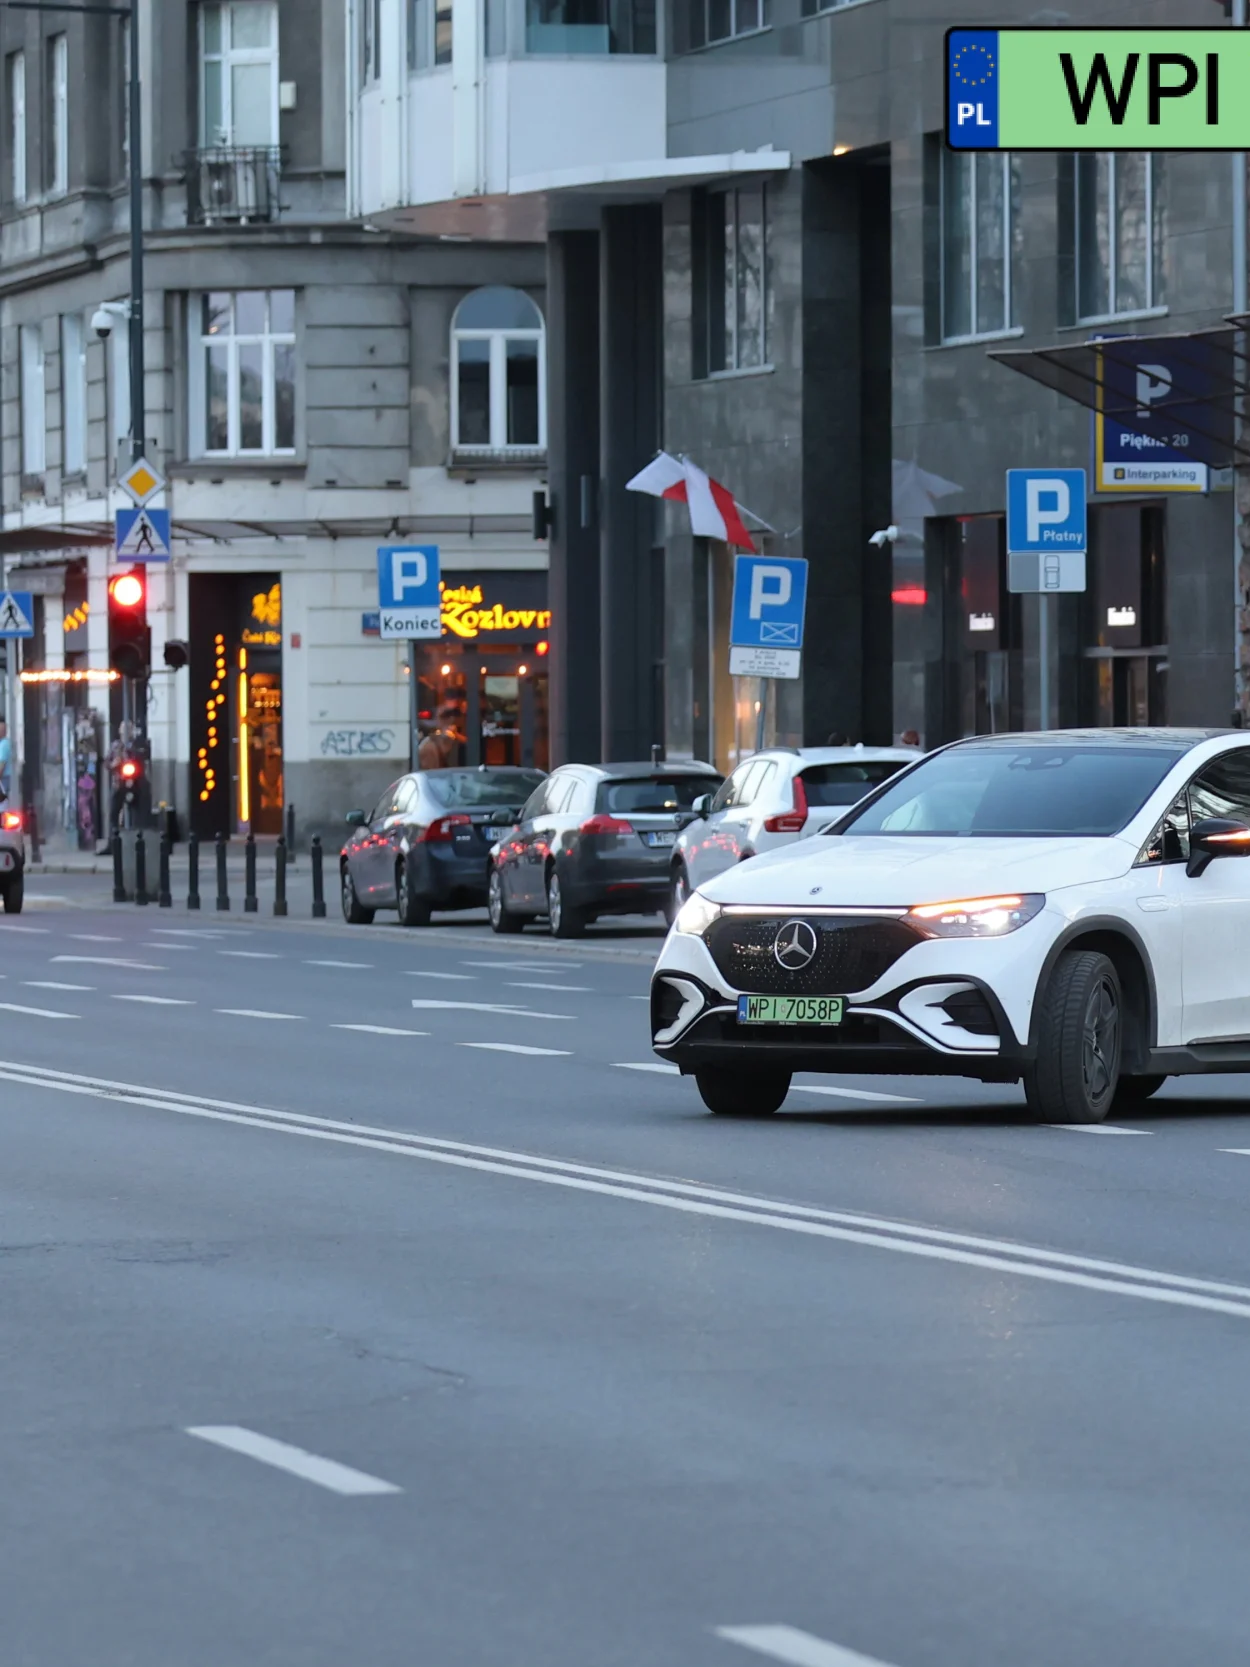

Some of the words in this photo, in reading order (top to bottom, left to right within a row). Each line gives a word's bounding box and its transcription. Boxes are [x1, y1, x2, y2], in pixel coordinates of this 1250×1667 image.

[1136, 364, 1173, 418] P
[1172, 434, 1189, 447] 20
[1127, 468, 1197, 483] Interparking
[1026, 478, 1070, 542] P
[1042, 529, 1083, 545] Płatny
[391, 551, 428, 601] P
[749, 564, 793, 620] P
[383, 614, 438, 631] Koniec
[748, 998, 777, 1019] WPI
[786, 999, 840, 1020] 7058P
